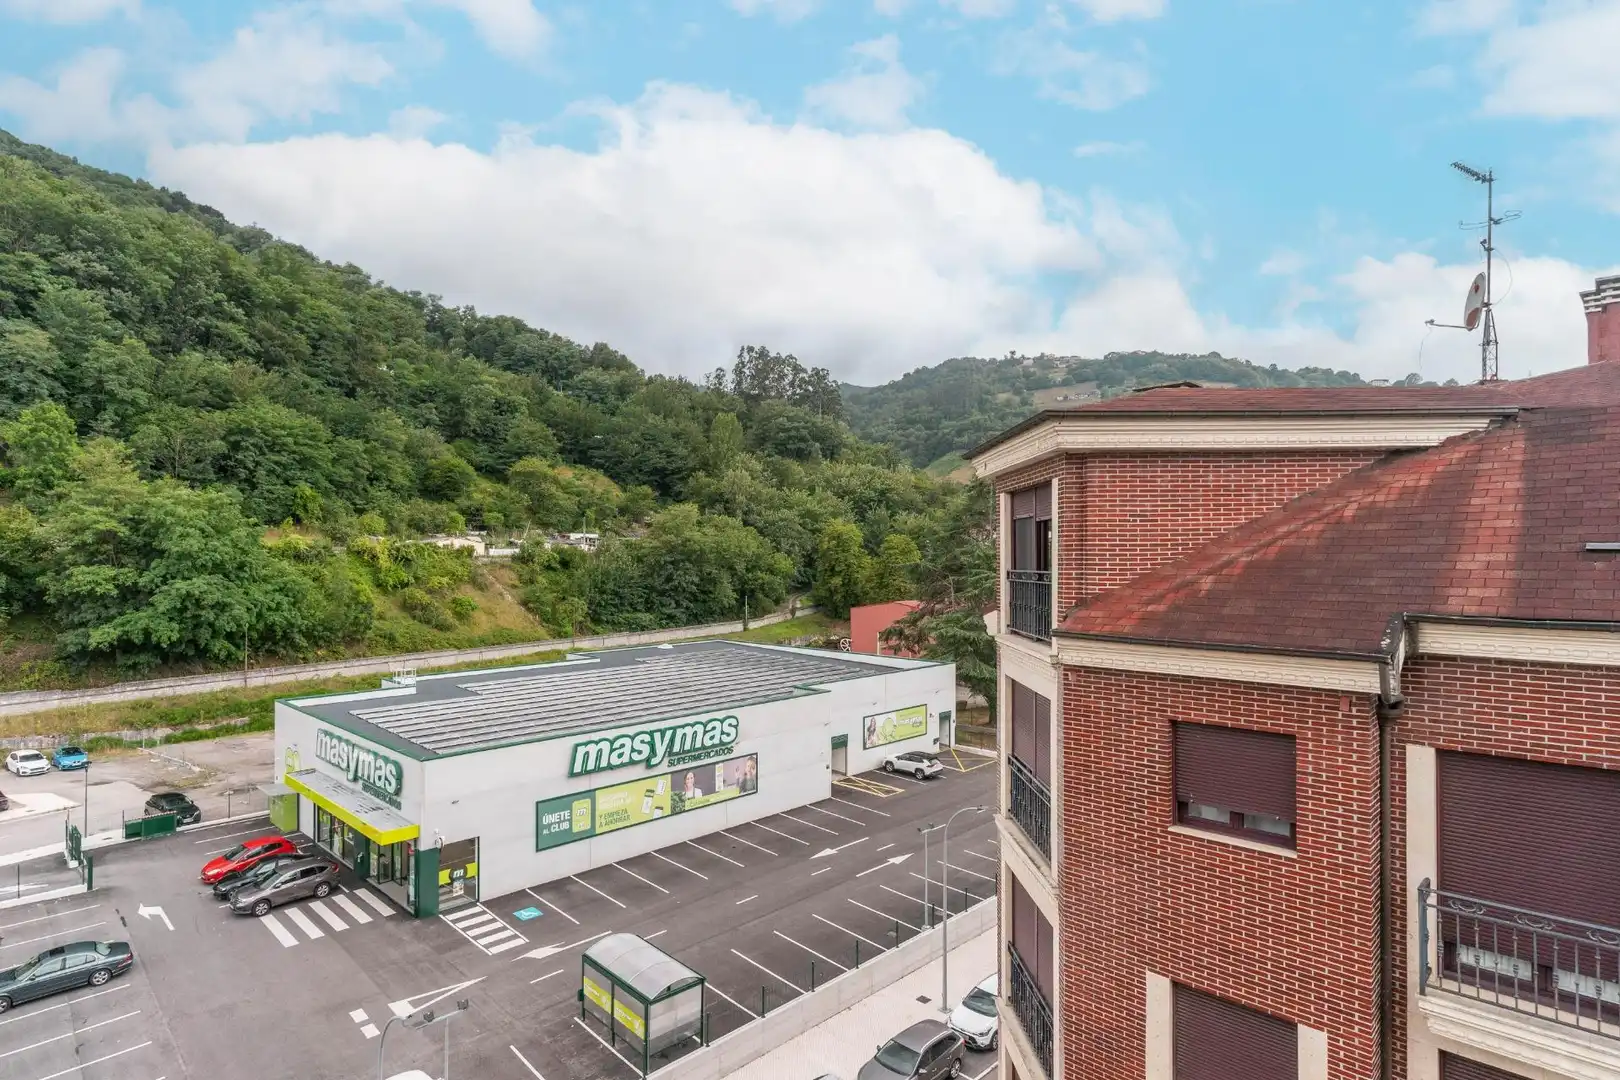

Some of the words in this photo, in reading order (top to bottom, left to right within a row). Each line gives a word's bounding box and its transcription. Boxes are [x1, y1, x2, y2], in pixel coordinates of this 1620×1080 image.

[570, 716, 739, 776] masymas
[667, 746, 734, 768] SUPERMERCADOS
[316, 729, 402, 795] masymas
[542, 810, 571, 825] ÚNETE
[550, 821, 570, 833] CLUB
